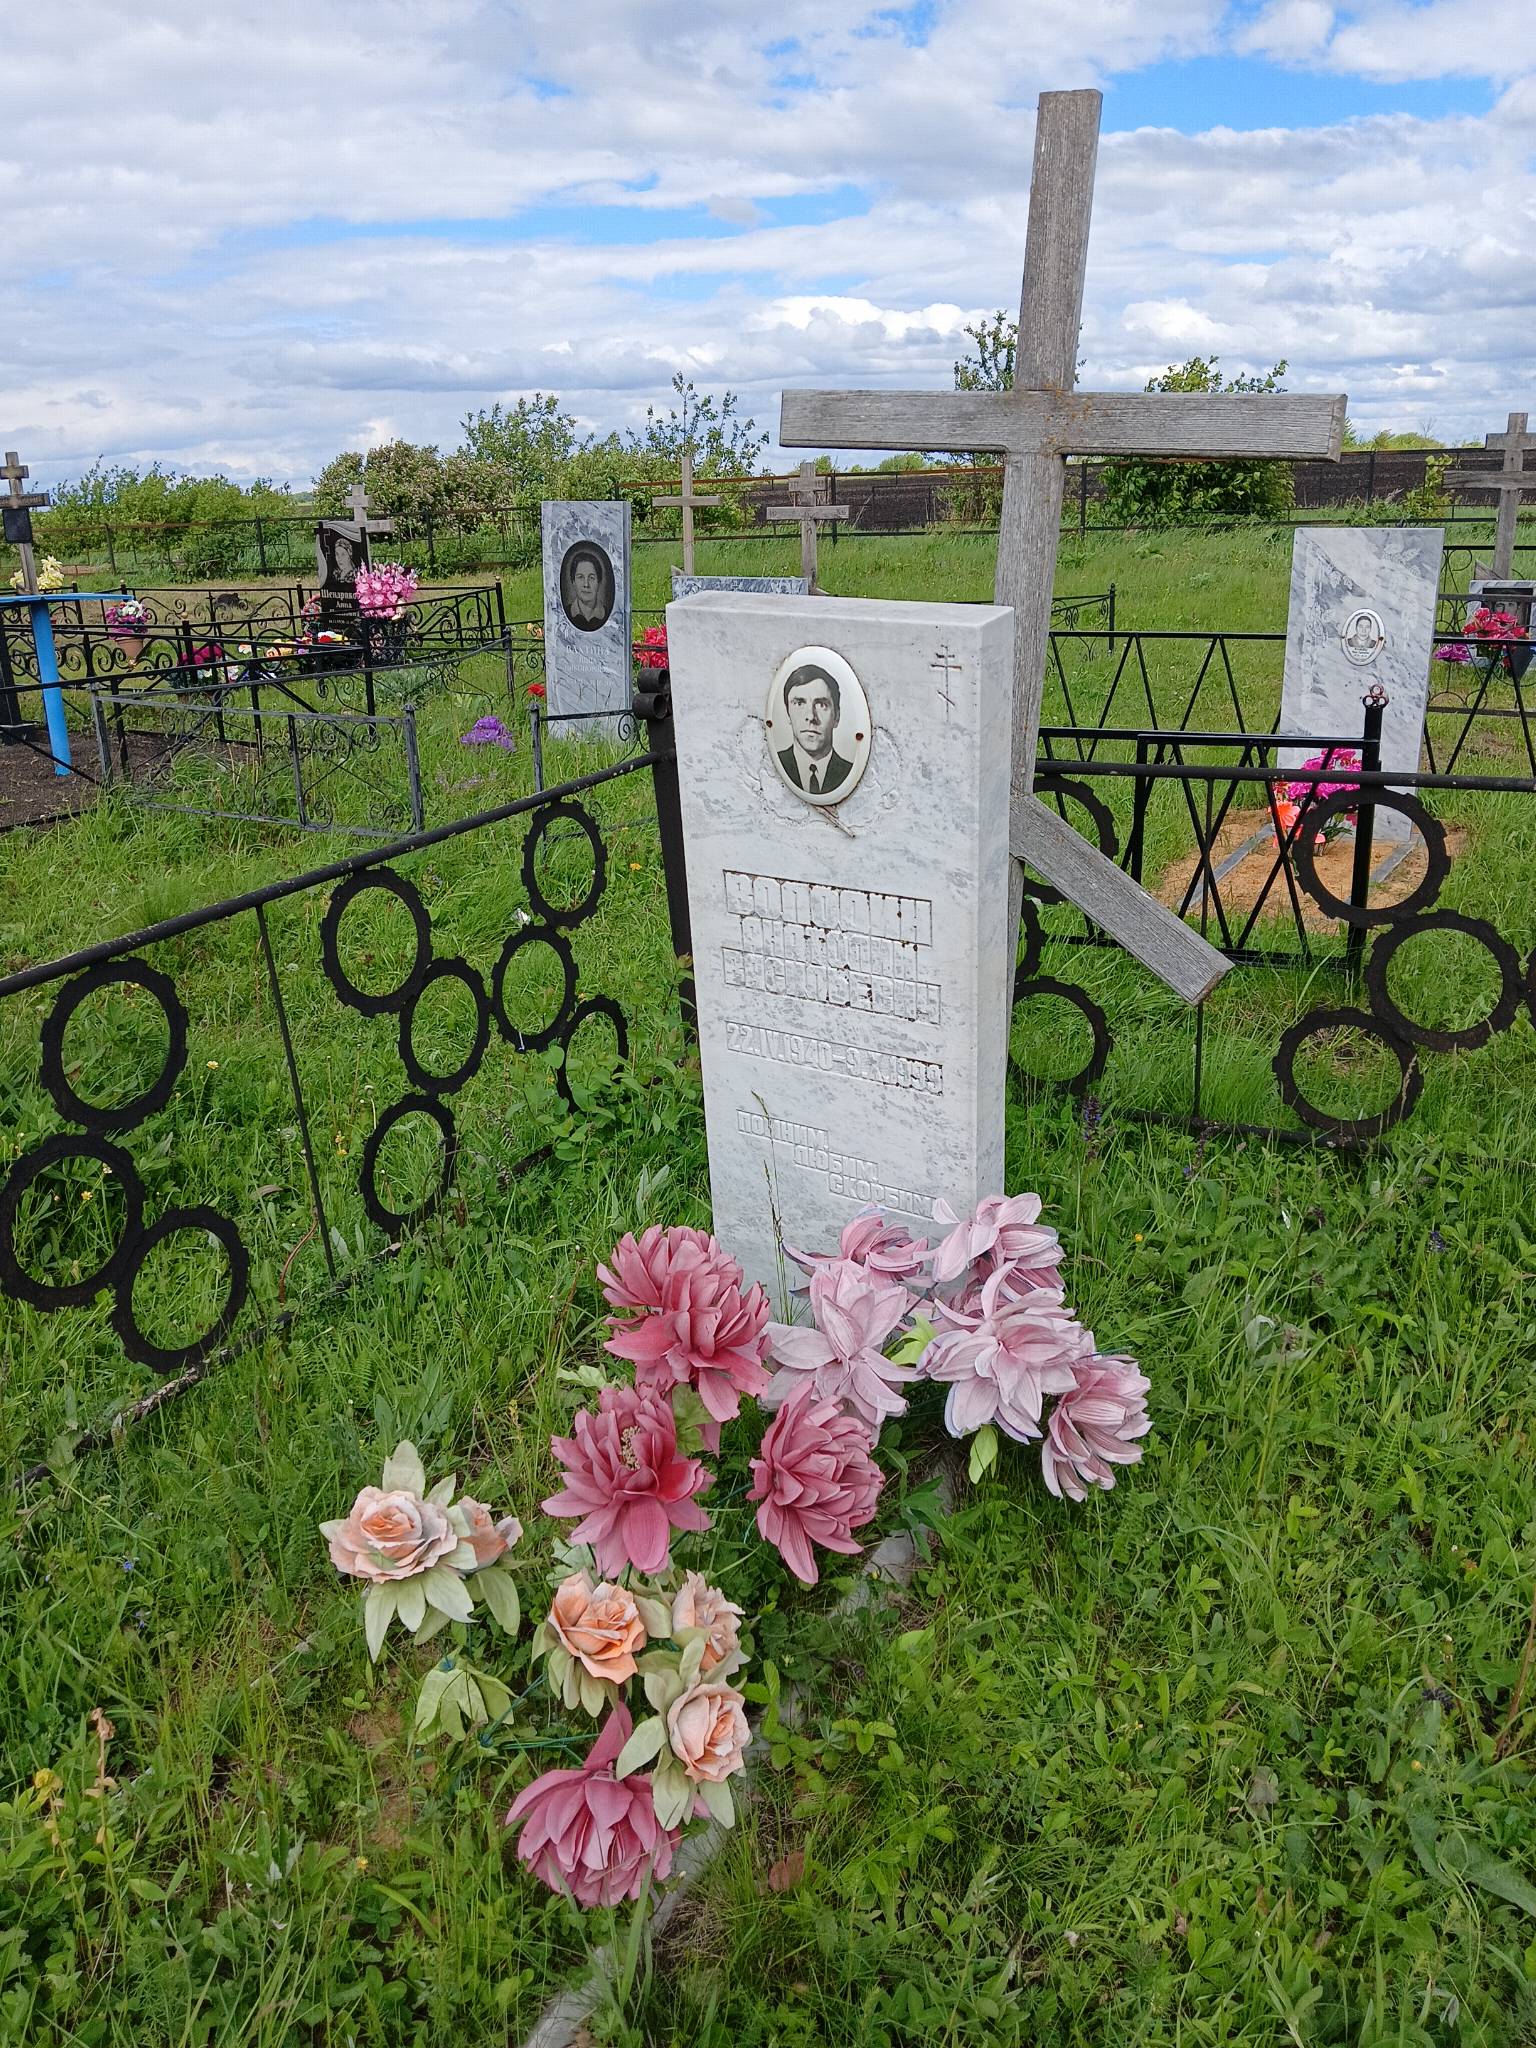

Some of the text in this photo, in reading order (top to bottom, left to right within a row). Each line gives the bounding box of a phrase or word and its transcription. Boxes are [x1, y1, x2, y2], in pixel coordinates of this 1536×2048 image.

[724, 871, 932, 945] ВОЛОДИН
[741, 915, 917, 982] АНАТОЛИЙ
[722, 947, 941, 1025] ВАСИЛЬЕВИЧ
